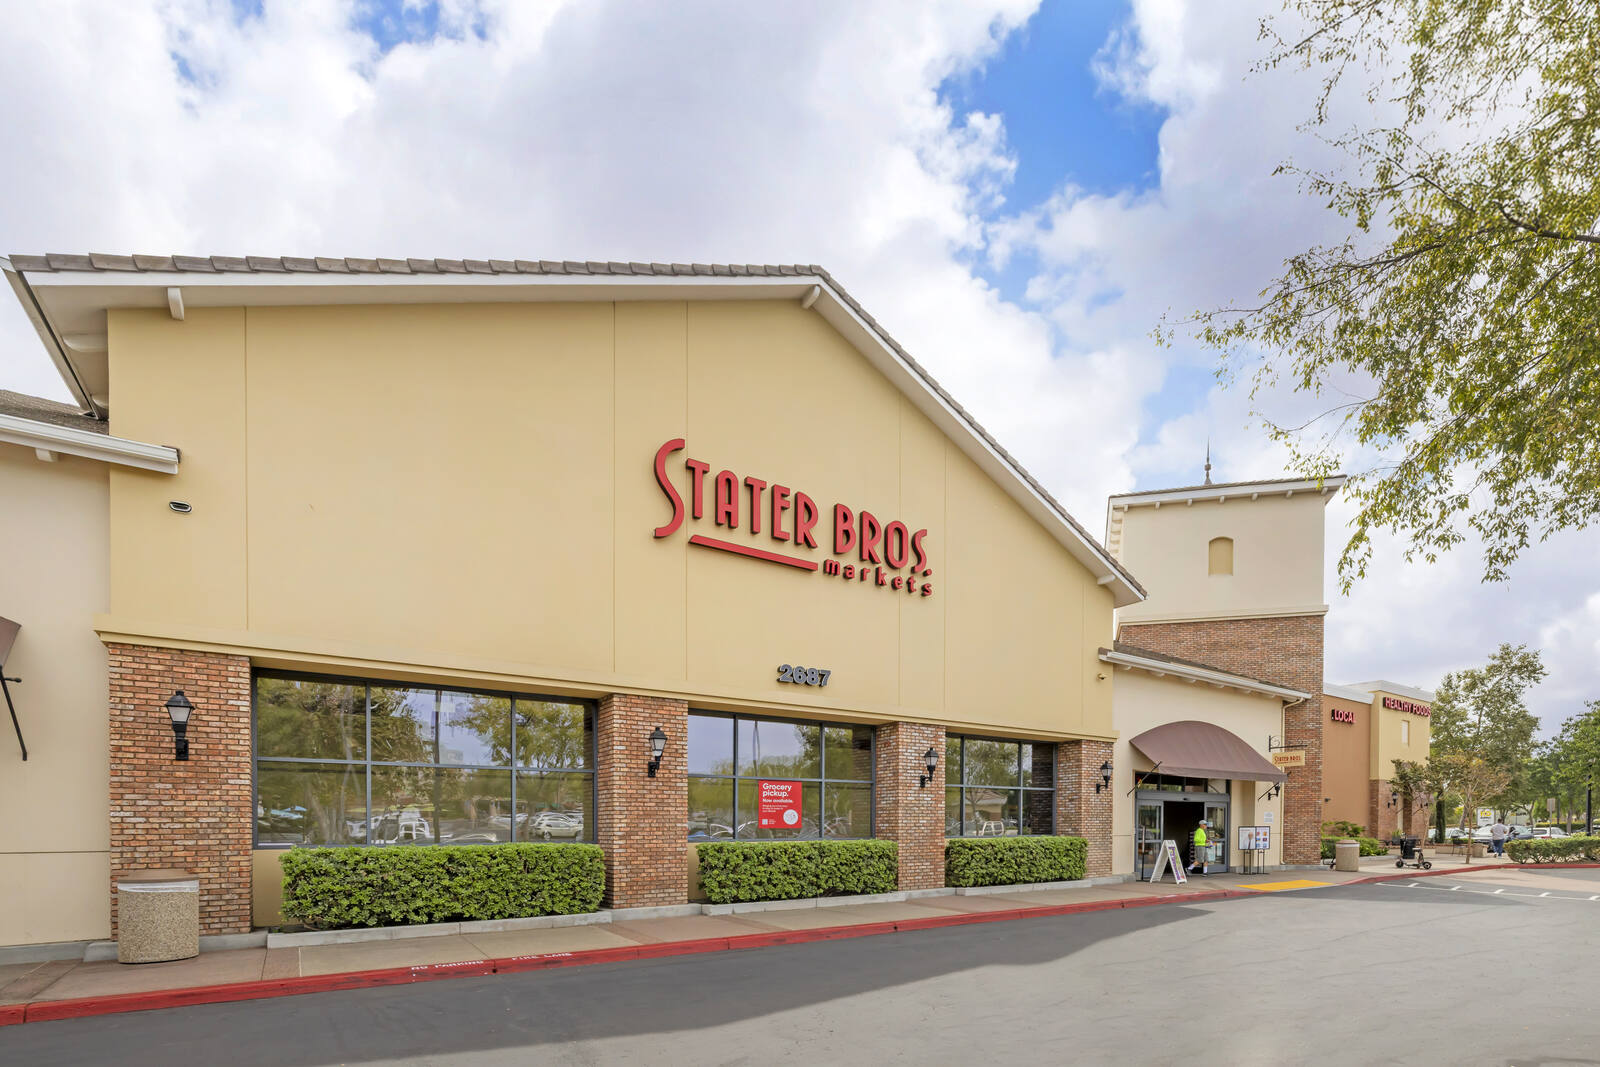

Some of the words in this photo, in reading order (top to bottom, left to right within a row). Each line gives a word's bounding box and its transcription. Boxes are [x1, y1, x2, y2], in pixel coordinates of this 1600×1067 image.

[653, 438, 819, 548] STATER
[833, 503, 932, 576] BROS.
[824, 558, 933, 597] markets
[777, 664, 831, 687] 2687
[1383, 696, 1411, 713] HEALTHY
[1412, 703, 1431, 717] FOODS
[762, 782, 792, 791] Grocery
